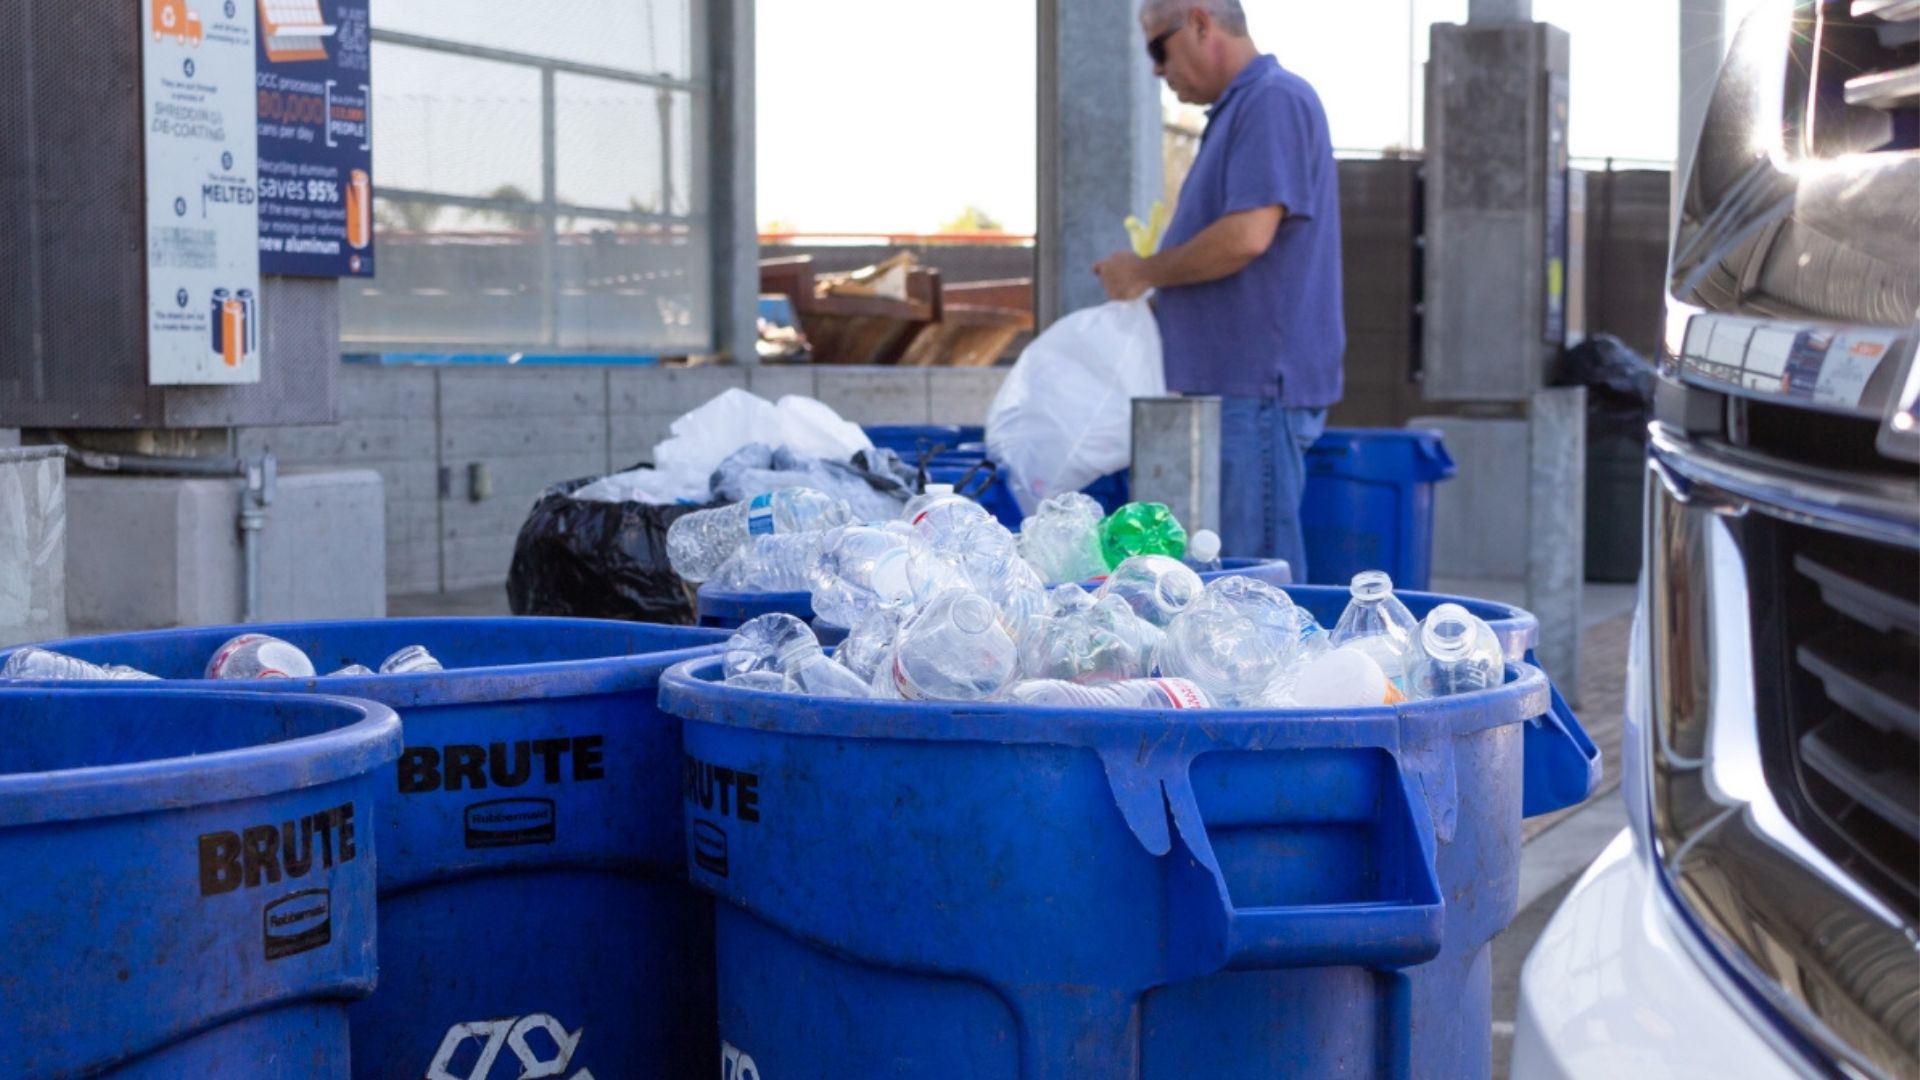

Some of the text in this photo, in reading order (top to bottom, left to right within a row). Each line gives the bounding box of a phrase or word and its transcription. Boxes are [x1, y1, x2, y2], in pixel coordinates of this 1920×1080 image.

[331, 120, 364, 137] PEOPLE
[203, 184, 256, 205] MELTED
[259, 177, 305, 200] saves
[307, 179, 339, 203] 95%
[259, 236, 340, 255] new aluminum
[399, 735, 603, 793] BRUTE
[471, 808, 549, 825] Rubbermaid
[199, 801, 356, 896] BRUTE
